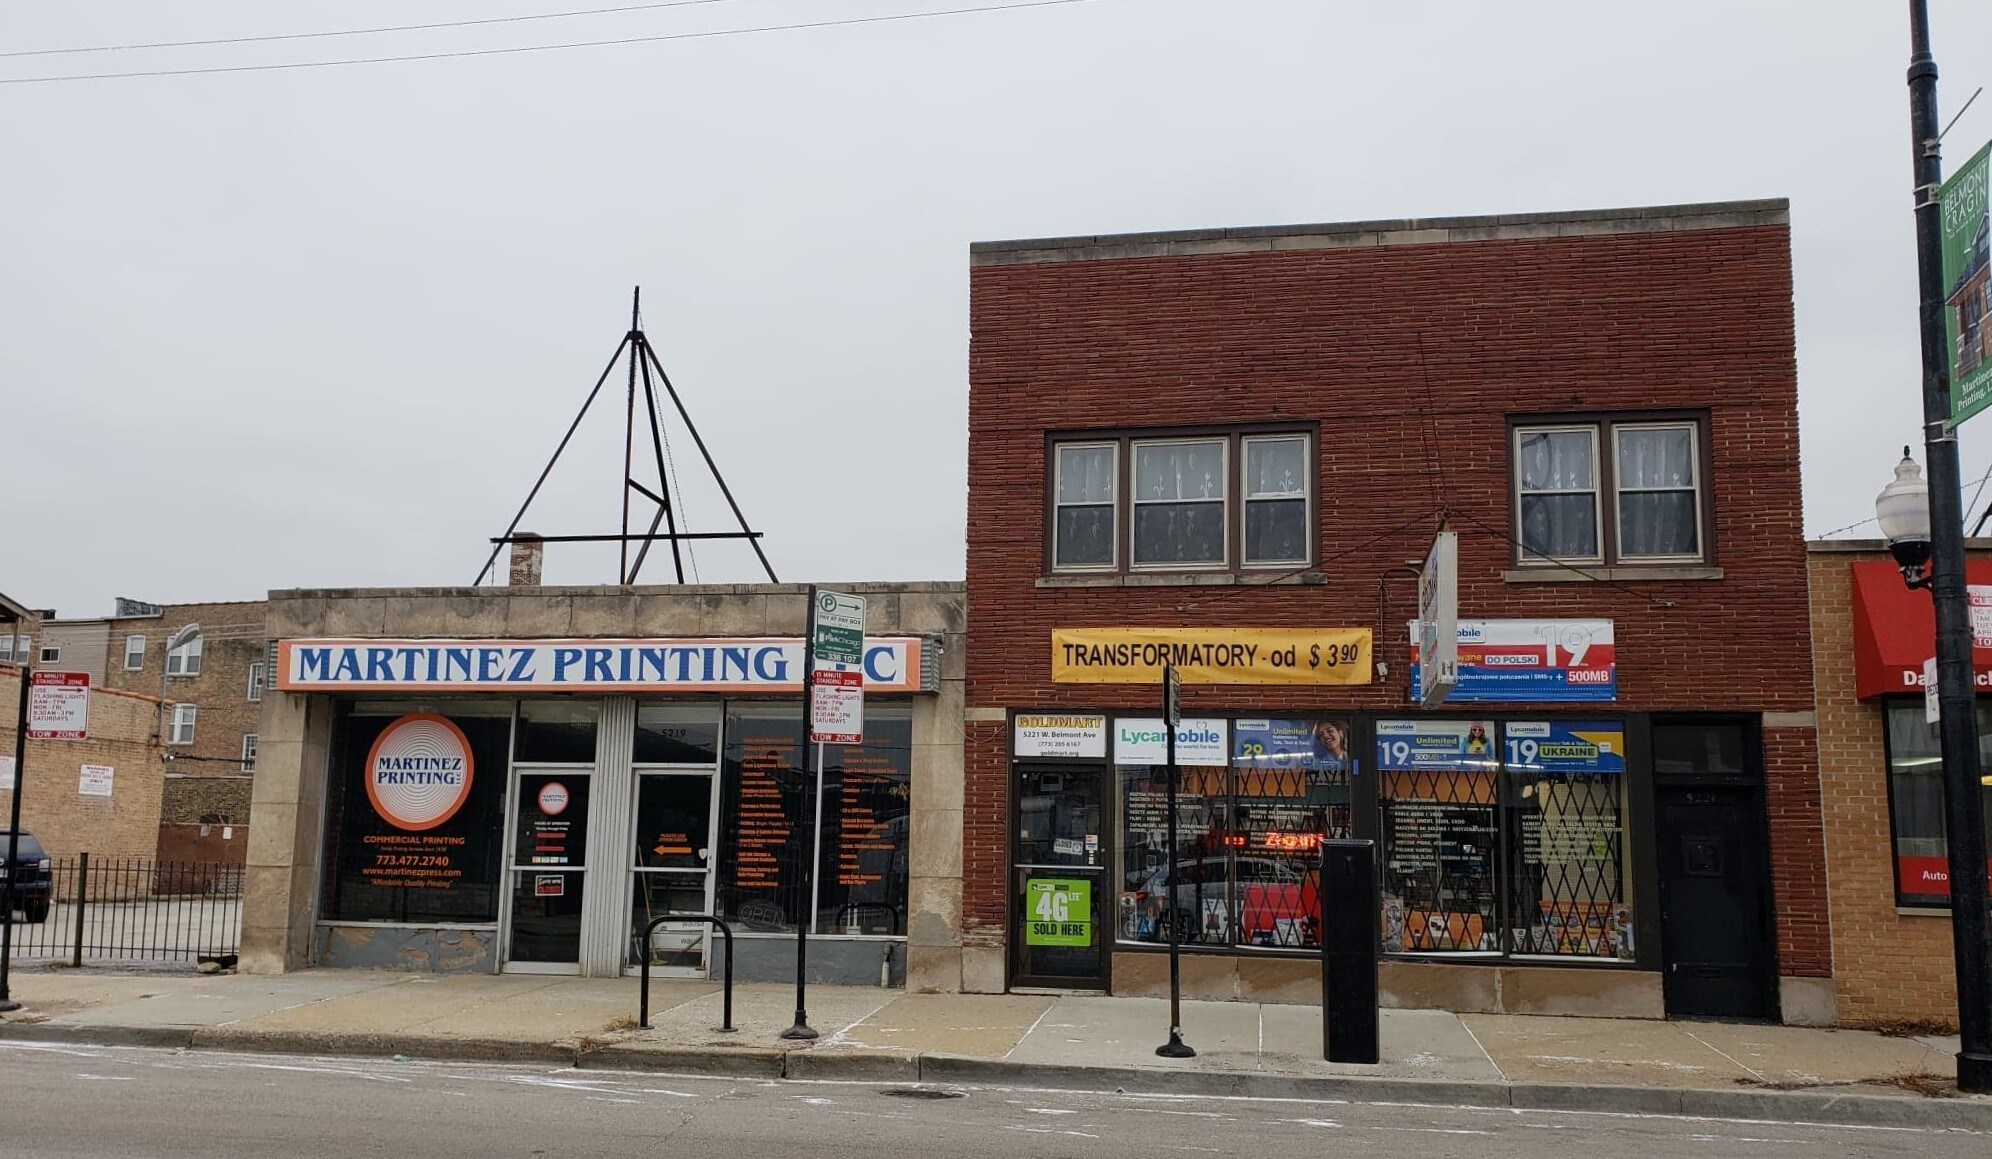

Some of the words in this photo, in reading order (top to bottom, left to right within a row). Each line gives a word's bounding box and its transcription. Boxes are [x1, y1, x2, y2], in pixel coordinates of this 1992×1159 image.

[1944, 163, 1987, 216] BELMONT
[1945, 182, 1986, 232] CRAGIN
[1063, 643, 1258, 667] TRANSFORMATORY
[1270, 645, 1295, 667] od
[1487, 656, 1501, 664] DO
[1503, 656, 1537, 664] POLSKI
[299, 648, 536, 681] MARTINEZ
[553, 647, 788, 681] PRINTING
[1568, 671, 1608, 682] 500MB
[1017, 716, 1103, 728] GOLDMART
[662, 728, 687, 738] 5219
[1273, 727, 1308, 735] Unlimited
[1416, 737, 1457, 745] Unlimited
[1542, 748, 1595, 757] UKRAINE
[379, 757, 461, 770] MARTINEZ
[378, 771, 455, 784] PRINTING
[363, 836, 421, 845] COMMERCIAL
[423, 837, 465, 845] PRINTING
[376, 855, 449, 866] 773.477.2740
[362, 867, 461, 877] www.martinezpress.com
[1922, 870, 1948, 880] Auto
[1035, 892, 1068, 922] 4G
[740, 905, 784, 926] OPEN
[1033, 923, 1058, 935] SOLD
[1061, 924, 1084, 936] HERE
